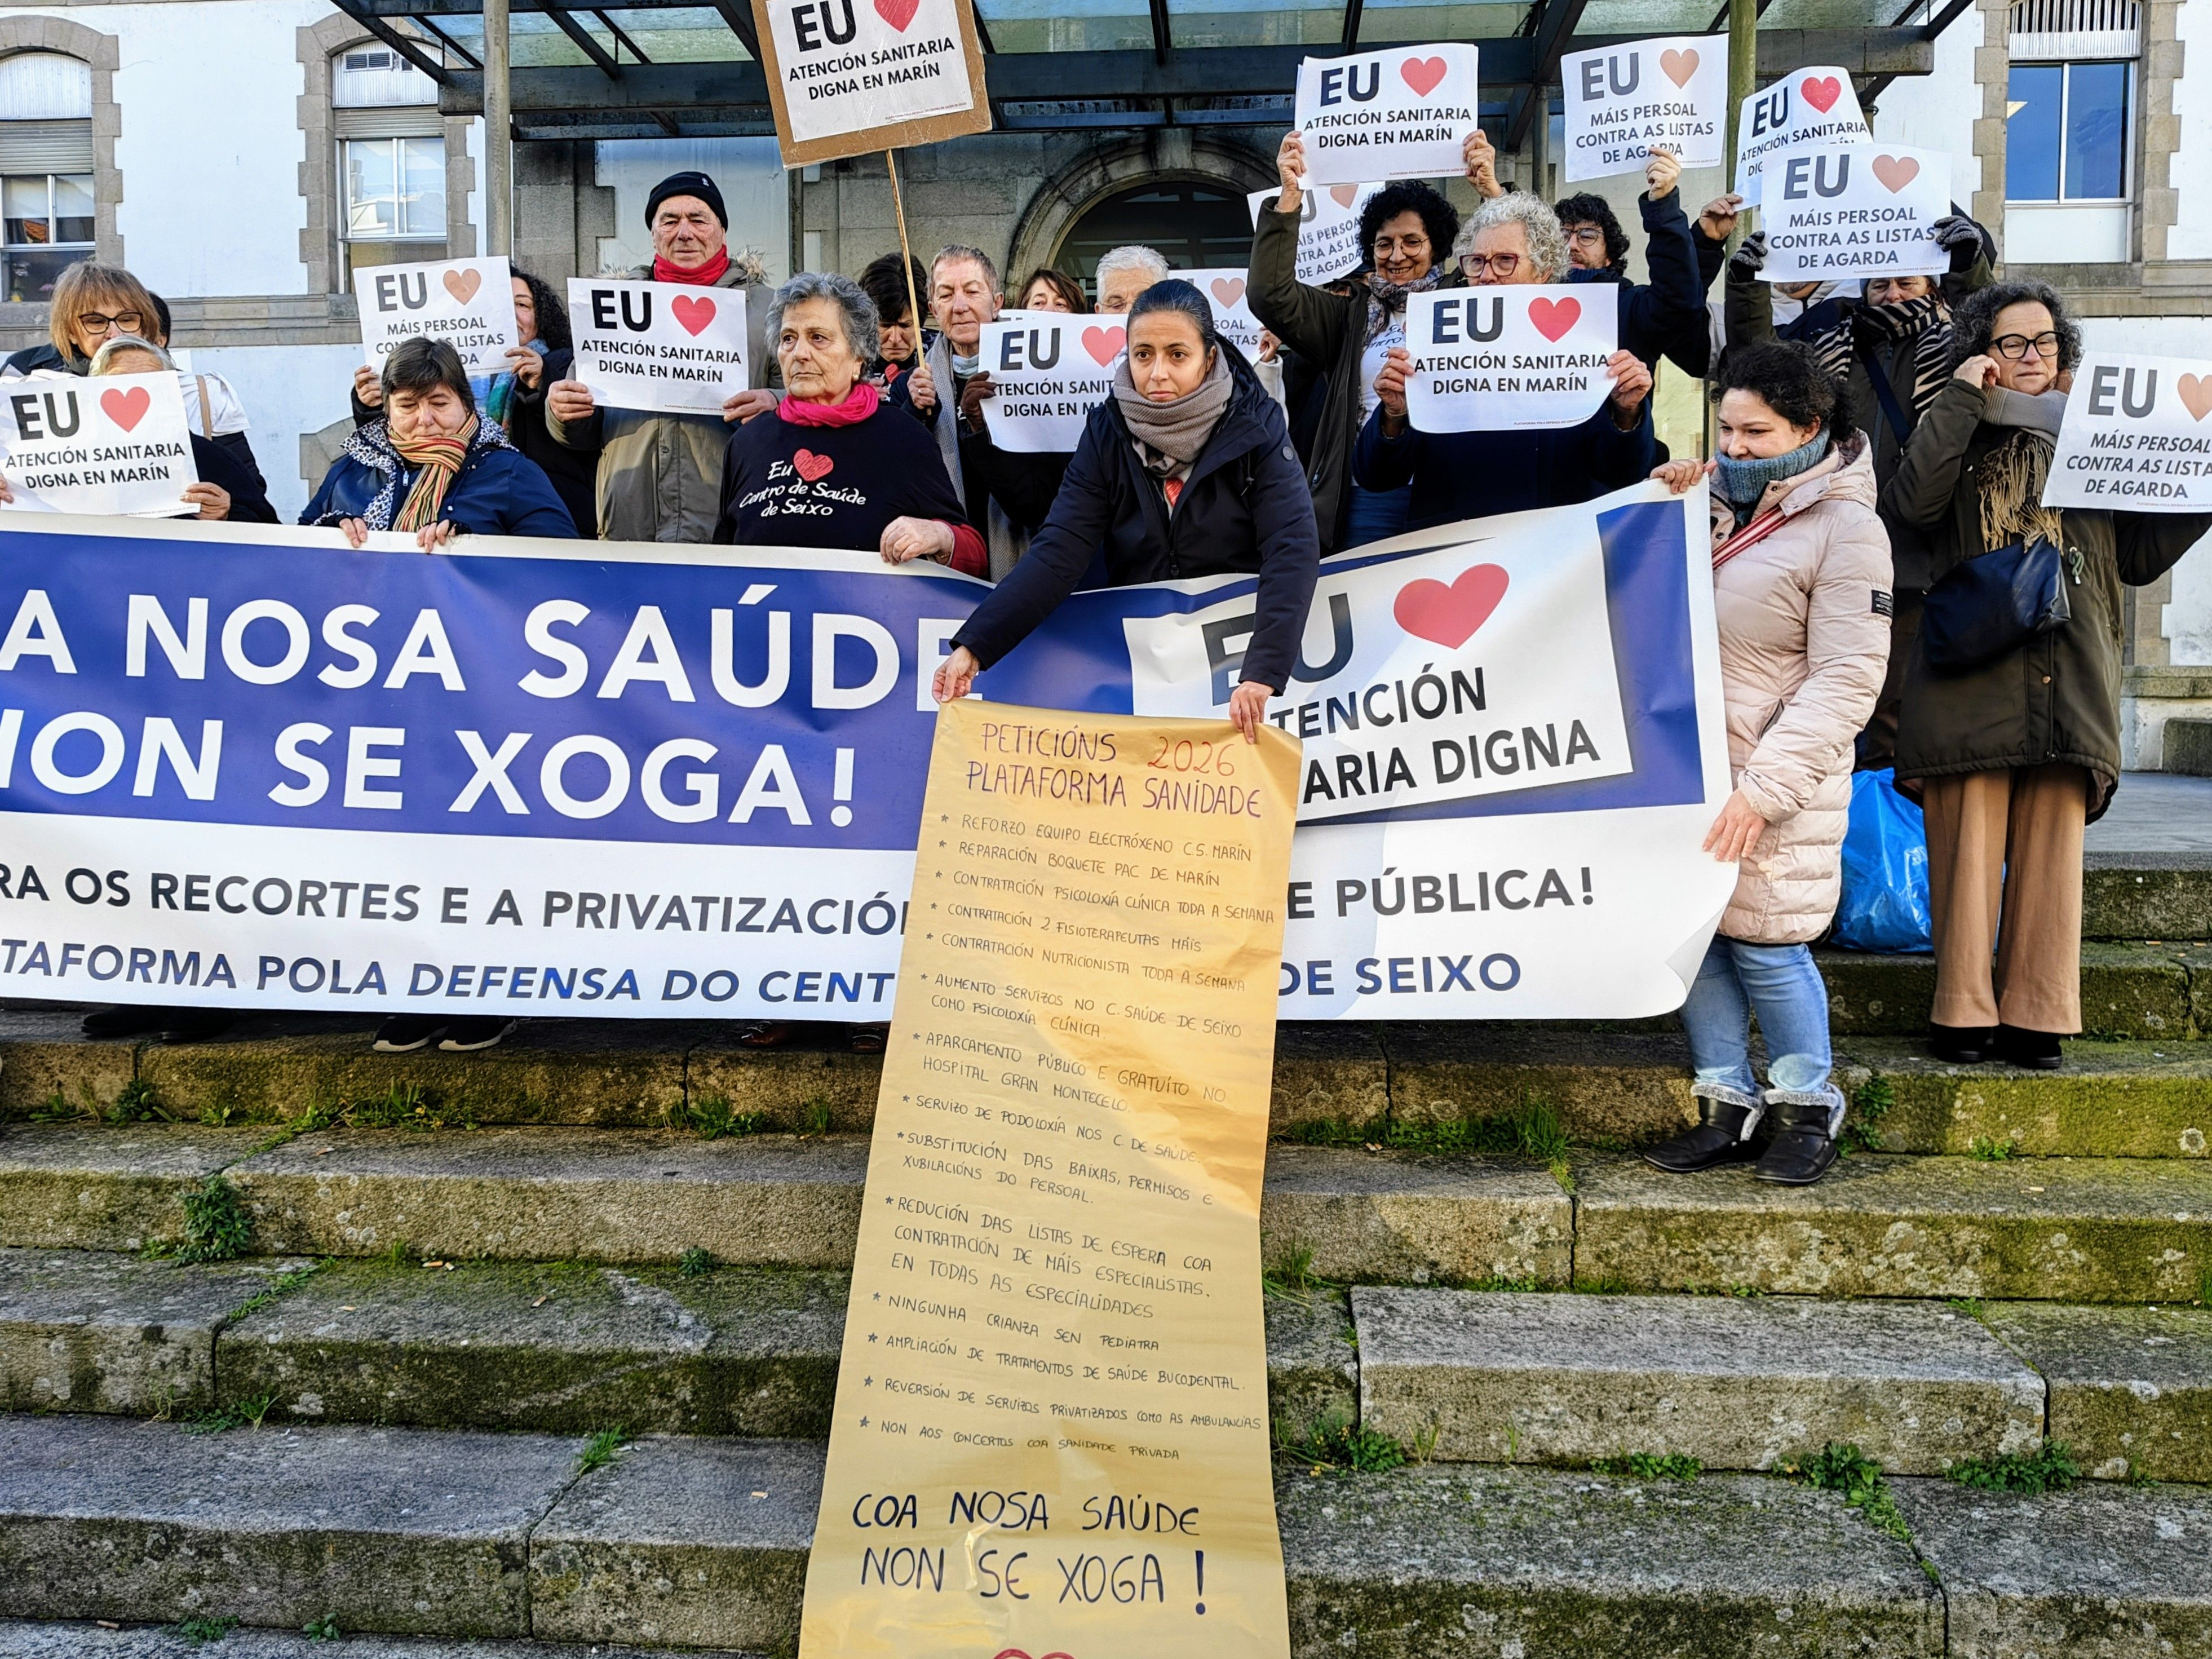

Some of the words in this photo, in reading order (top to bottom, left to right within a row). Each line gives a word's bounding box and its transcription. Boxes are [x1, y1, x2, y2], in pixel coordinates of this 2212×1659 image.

[791, 0, 856, 52] EU
[790, 52, 866, 81] ATENCIÓN
[871, 37, 954, 65] SANITARIA
[1581, 52, 1639, 101] EU
[809, 79, 859, 100] DIGNA
[863, 73, 883, 89] EN
[888, 60, 940, 85] MARÍN
[1320, 62, 1379, 107] EU
[1304, 109, 1381, 131] ATENCIÓN
[1387, 108, 1471, 122] SANITARIA
[1591, 107, 1628, 126] MÁIS
[1634, 103, 1697, 120] PERSOAL
[1752, 86, 1788, 138] EU
[1320, 133, 1369, 148] DIGNA
[1375, 131, 1393, 144] EN
[1400, 124, 1452, 143] MARÍN
[1576, 127, 1639, 148] CONTRA
[1643, 123, 1664, 138] AS
[1670, 122, 1713, 135] LISTAS
[1741, 134, 1788, 163] ATENCIÓN
[1793, 122, 1866, 142] SANITARIA
[1603, 150, 1620, 163] DE
[1784, 154, 1850, 200] EU
[1789, 209, 1831, 227] MÁIS
[1838, 207, 1917, 224] PERSOAL
[1771, 233, 1841, 249] CONTRA
[1847, 231, 1870, 245] AS
[1877, 227, 1935, 243] LISTAS
[1799, 255, 1817, 268] DE
[1823, 250, 1898, 267] AGARDA
[375, 272, 427, 312] EU
[591, 290, 651, 331] EU
[388, 320, 420, 335] MÁIS
[424, 317, 486, 332] PERSOAL
[457, 334, 504, 347] LISTAS
[1432, 297, 1503, 344] EU
[582, 340, 654, 356] ATENCIÓN
[661, 346, 741, 364] SANITARIA
[1000, 328, 1060, 370] EU
[1414, 351, 1505, 373] ATENCIÓN
[1512, 354, 1609, 370] SANITARIA
[599, 360, 645, 375] DIGNA
[650, 365, 667, 378] EN
[673, 366, 722, 382] MARÍN
[997, 378, 1063, 396] TENCIÓN
[1069, 380, 1114, 394] SANIT
[1434, 378, 1491, 394] DIGNA
[1498, 378, 1519, 391] EN
[1527, 372, 1586, 392] MARÍN
[1004, 404, 1052, 417] DIGNA
[1058, 402, 1077, 415] EN
[2088, 366, 2157, 418] EU
[10, 391, 79, 440] EU
[6, 446, 87, 468] ATENCIÓN
[94, 443, 185, 461] SANITARIA
[2091, 430, 2134, 449] MÁIS
[2137, 436, 2210, 453] PERSOAL
[25, 473, 79, 488] DIGNA
[83, 471, 105, 484] EN
[111, 462, 169, 483] MARÍN
[768, 461, 793, 480] Eu
[2067, 455, 2133, 472] CONTRA
[2137, 459, 2162, 473] AS
[2165, 460, 2212, 476] LISTA
[740, 485, 785, 508] Centro
[788, 478, 808, 494] de
[812, 483, 866, 505] Saúde
[761, 501, 778, 516] de
[782, 498, 833, 515] Seixo
[2085, 479, 2106, 493] DE
[2108, 480, 2188, 498] AGARDA
[126, 594, 467, 691] NOSA
[1270, 663, 1487, 739] TENCIÓN
[982, 723, 1116, 762] PETICIÓNS
[1148, 736, 1235, 777] 2026
[1303, 747, 1417, 804] ARIA
[1432, 720, 1600, 784] DIGNA
[267, 723, 405, 811] SE
[448, 729, 855, 828] XOGA!
[966, 761, 1126, 807] PLATAFORMA
[1143, 778, 1260, 818] SANIDADE
[962, 814, 1025, 835] REFORZO
[1036, 824, 1080, 840] EQUIPO
[1089, 831, 1173, 853] ELECTRÓXENO
[1213, 844, 1251, 861] MARÍN
[959, 842, 1037, 864] REPARACIÓN
[1048, 853, 1105, 874] BOQUETE
[1115, 863, 1139, 877] PAC
[1150, 867, 1169, 880] DE
[1176, 870, 1219, 886] MARÍN
[0, 863, 50, 901] RA
[65, 868, 130, 906] OS
[151, 873, 420, 921] RECORTES
[441, 887, 468, 923] E
[486, 890, 523, 926] A
[543, 891, 909, 935] PRIVATIZACIÓ
[954, 871, 1043, 897] CONTRATACIÓN
[1054, 887, 1118, 906] PSICOLOXÍA
[1125, 893, 1169, 912] CLÍNICA
[1177, 902, 1205, 915] TODA
[1212, 905, 1219, 917] A
[1224, 905, 1273, 923] SEMANA
[1337, 867, 1593, 917] PÚBLICA!
[2, 939, 236, 988] TAFORMA
[257, 956, 387, 995] POLA
[407, 963, 640, 1000] DEFENSA
[661, 970, 739, 1002] DO
[759, 971, 895, 1002] CENT
[1356, 953, 1520, 994] SEIXO
[898, 1197, 968, 1223] REDUCIÓN
[981, 1214, 1012, 1233] DAS
[1029, 1224, 1072, 1244] LISTAS
[1082, 1235, 1102, 1252] DE
[1112, 1241, 1166, 1267] ESPERA
[1184, 1256, 1211, 1271] COA
[889, 1295, 966, 1322] NINGUNHA
[987, 1313, 1038, 1337] CRIANZA
[1054, 1329, 1081, 1344] SEN
[1100, 1335, 1158, 1350] PEDIATRA
[886, 1335, 957, 1355] AMPLIACIÓN
[967, 1347, 984, 1361] DE
[996, 1353, 1073, 1377] TRATAMENTOS
[1083, 1366, 1099, 1379] DE
[1108, 1368, 1148, 1382] SAÚDE
[1157, 1370, 1245, 1390] BUCODENTAL.
[885, 1378, 949, 1398] REVERSIÓN
[958, 1391, 975, 1404] DE
[985, 1395, 1039, 1413] SERVIZOS
[1050, 1404, 1127, 1419] PRIVATIZADOS
[1137, 1410, 1162, 1423] COMO
[1170, 1413, 1183, 1423] AS
[1191, 1414, 1260, 1429] AMBULANCIAS
[881, 1421, 906, 1435] NON
[919, 1426, 943, 1439] AOS
[953, 1432, 1013, 1446] CONCERTOS
[1059, 1439, 1116, 1452] SANIDADE
[1129, 1446, 1179, 1459] PRIVADA
[853, 1493, 917, 1529] COA
[950, 1488, 1049, 1533] NOSA
[1082, 1493, 1199, 1537] SAÚDE
[861, 1546, 944, 1594] NON
[979, 1549, 1029, 1602] SE
[1058, 1552, 1163, 1604] XOGA
